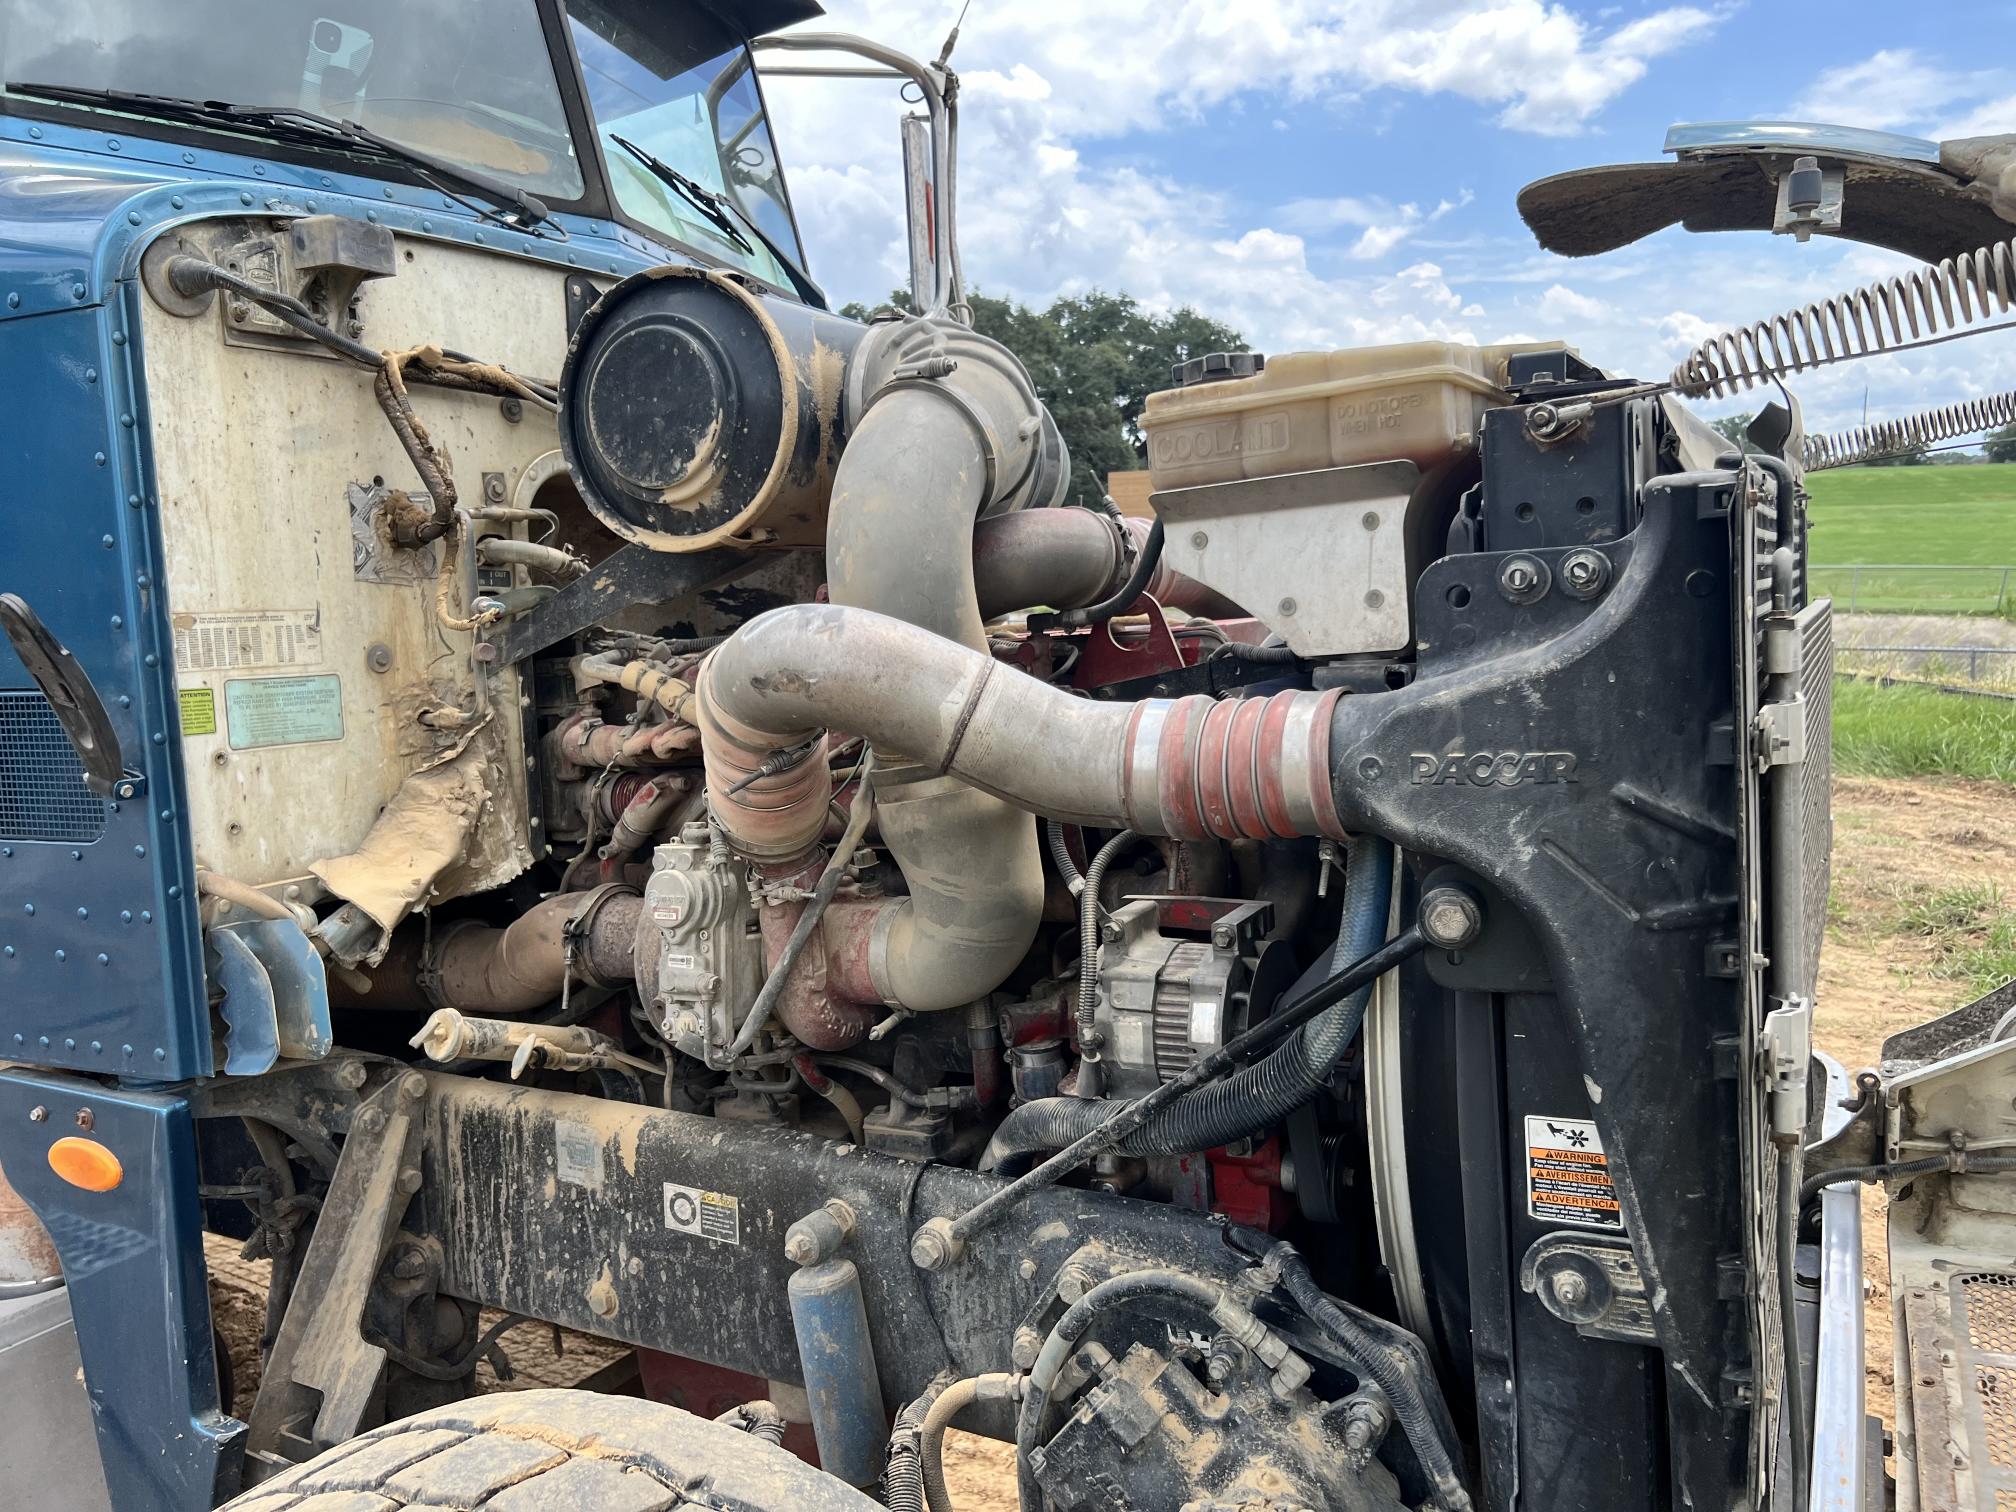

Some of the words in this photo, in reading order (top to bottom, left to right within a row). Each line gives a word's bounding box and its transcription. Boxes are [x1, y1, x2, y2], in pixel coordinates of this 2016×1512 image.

[1157, 421, 1280, 464] COOLANT
[1410, 752, 1578, 788] PACCAR
[1553, 1152, 1602, 1163] WARNING
[1545, 1194, 1616, 1209] ADVERTENCIA
